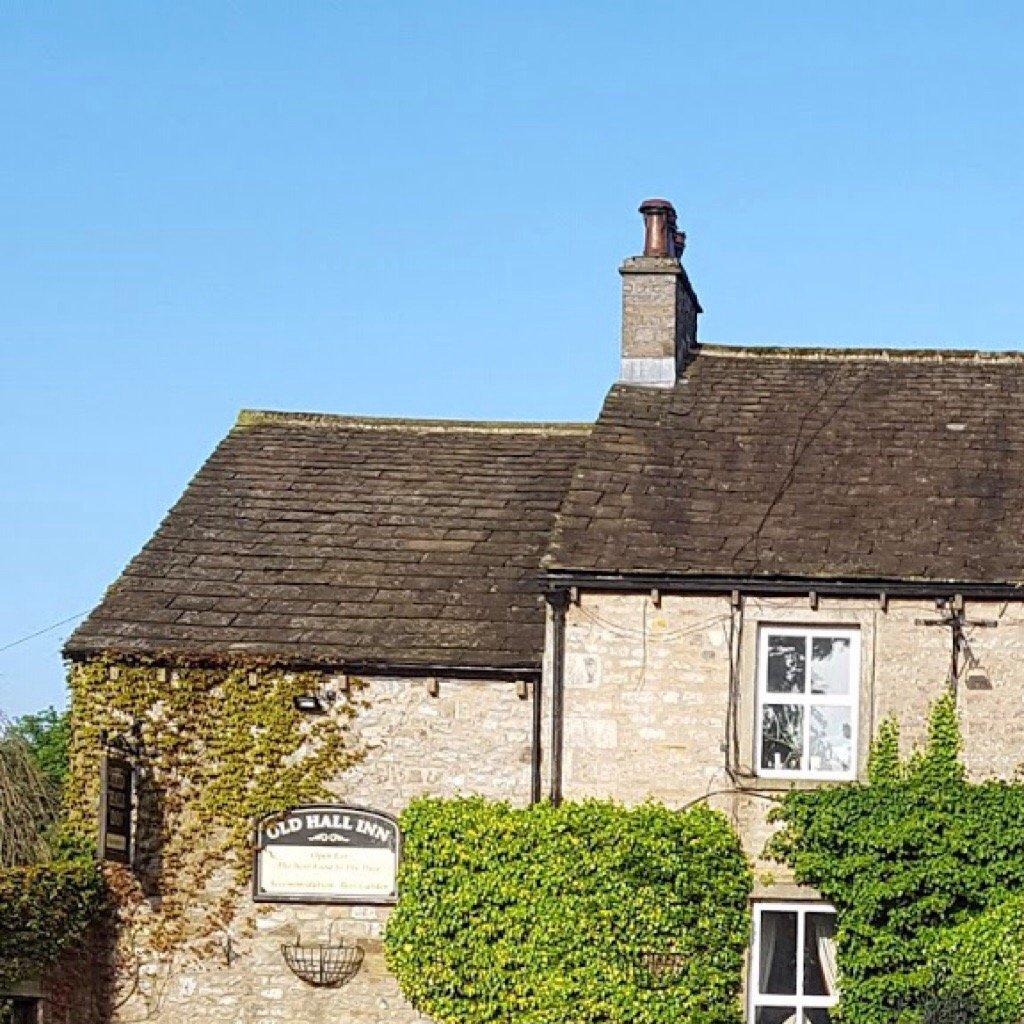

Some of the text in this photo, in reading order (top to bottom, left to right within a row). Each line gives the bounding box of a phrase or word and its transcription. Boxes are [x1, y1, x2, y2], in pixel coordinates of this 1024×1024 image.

[266, 813, 392, 842] OLD HALL INN
